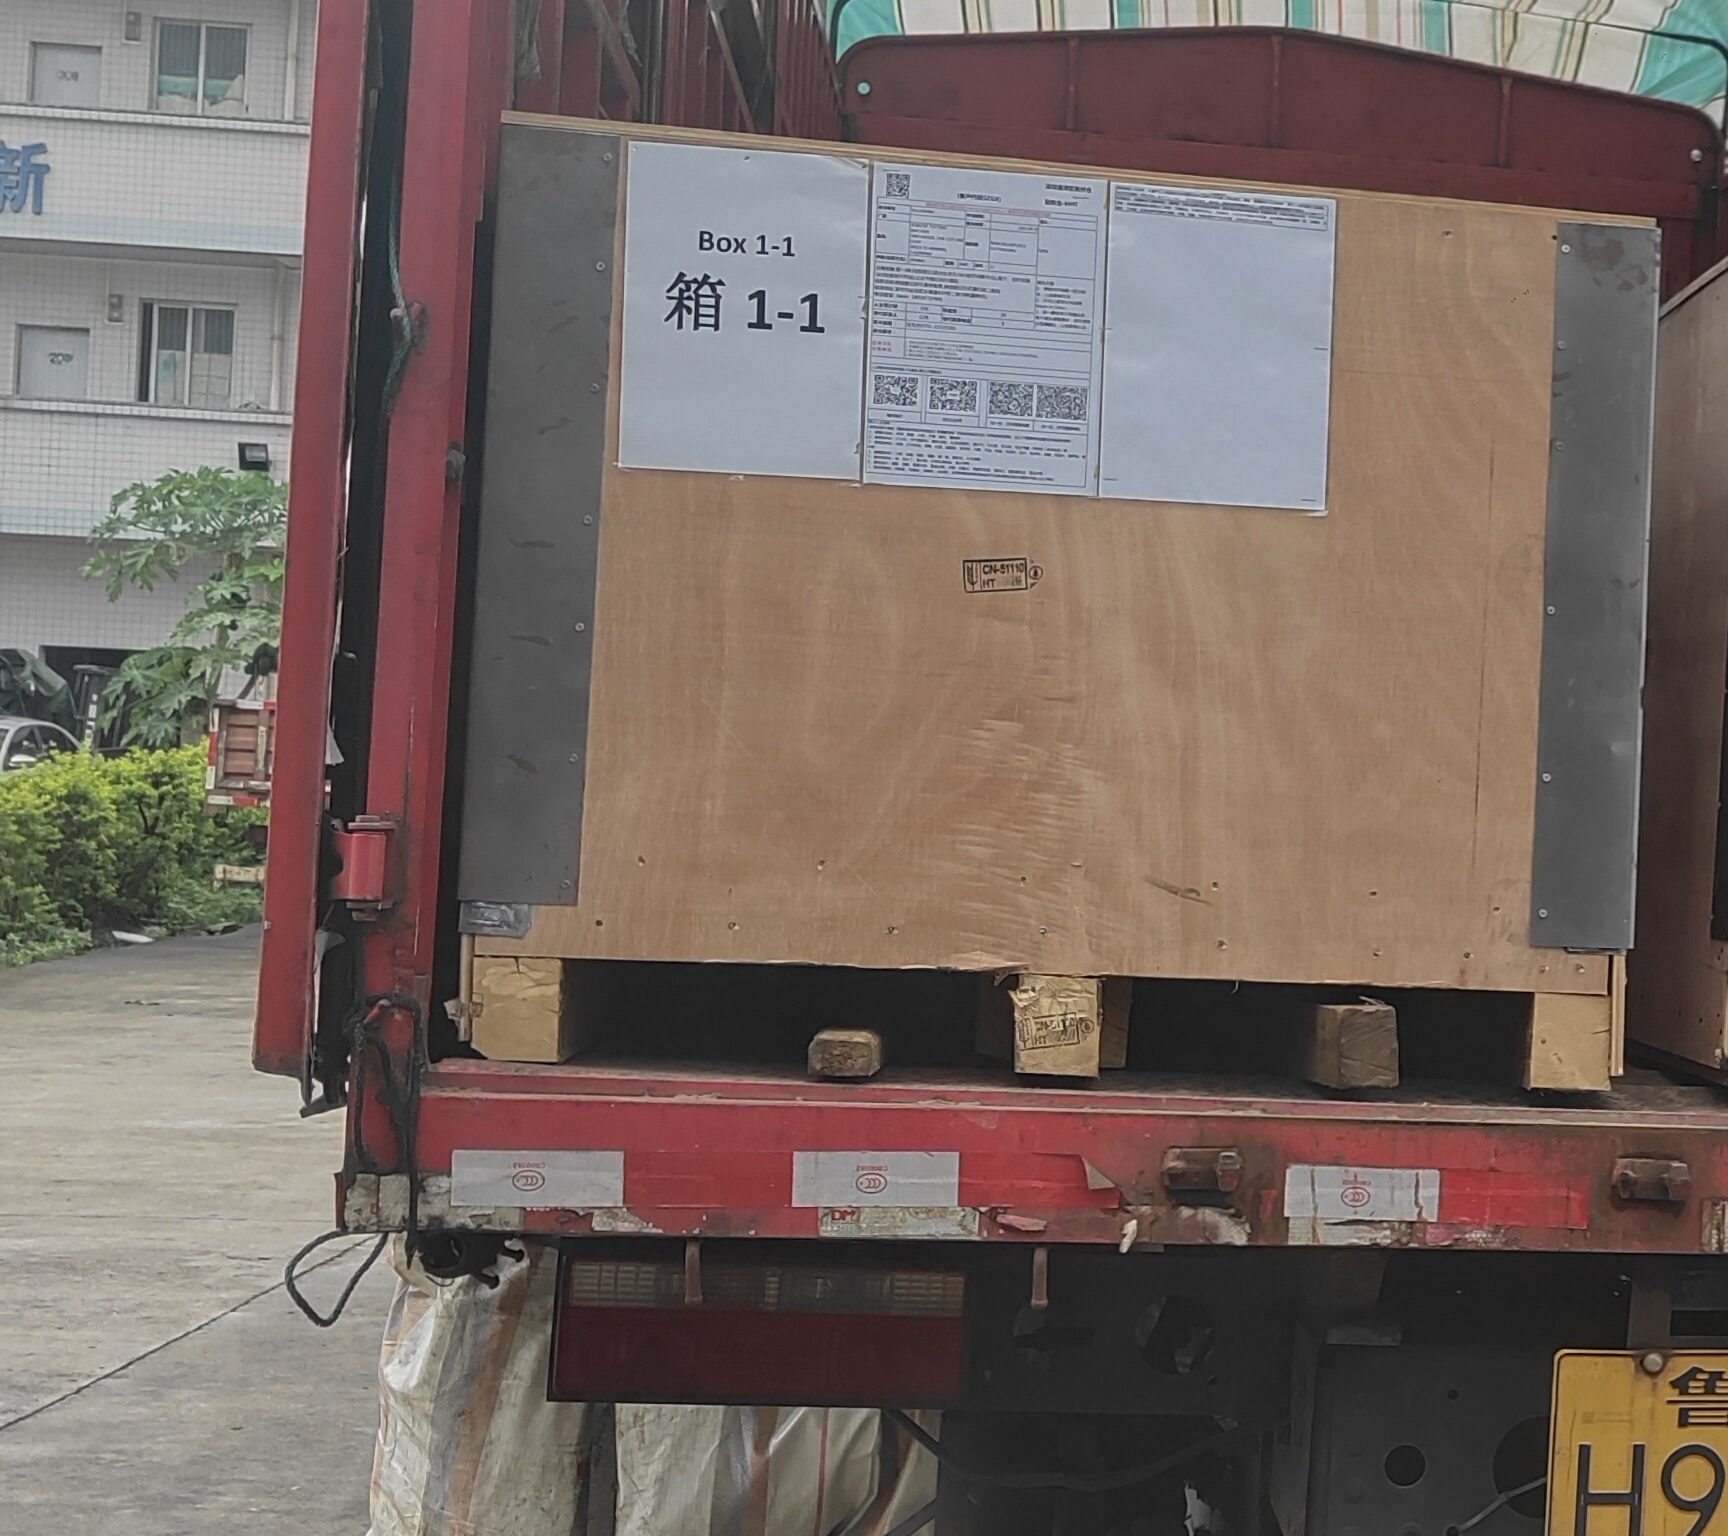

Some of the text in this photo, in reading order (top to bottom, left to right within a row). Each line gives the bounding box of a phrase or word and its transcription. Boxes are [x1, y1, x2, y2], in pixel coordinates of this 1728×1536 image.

[699, 230, 796, 257] Box 1-1
[664, 271, 727, 332] 箱
[747, 289, 825, 334] 1-1
[982, 578, 996, 588] HT
